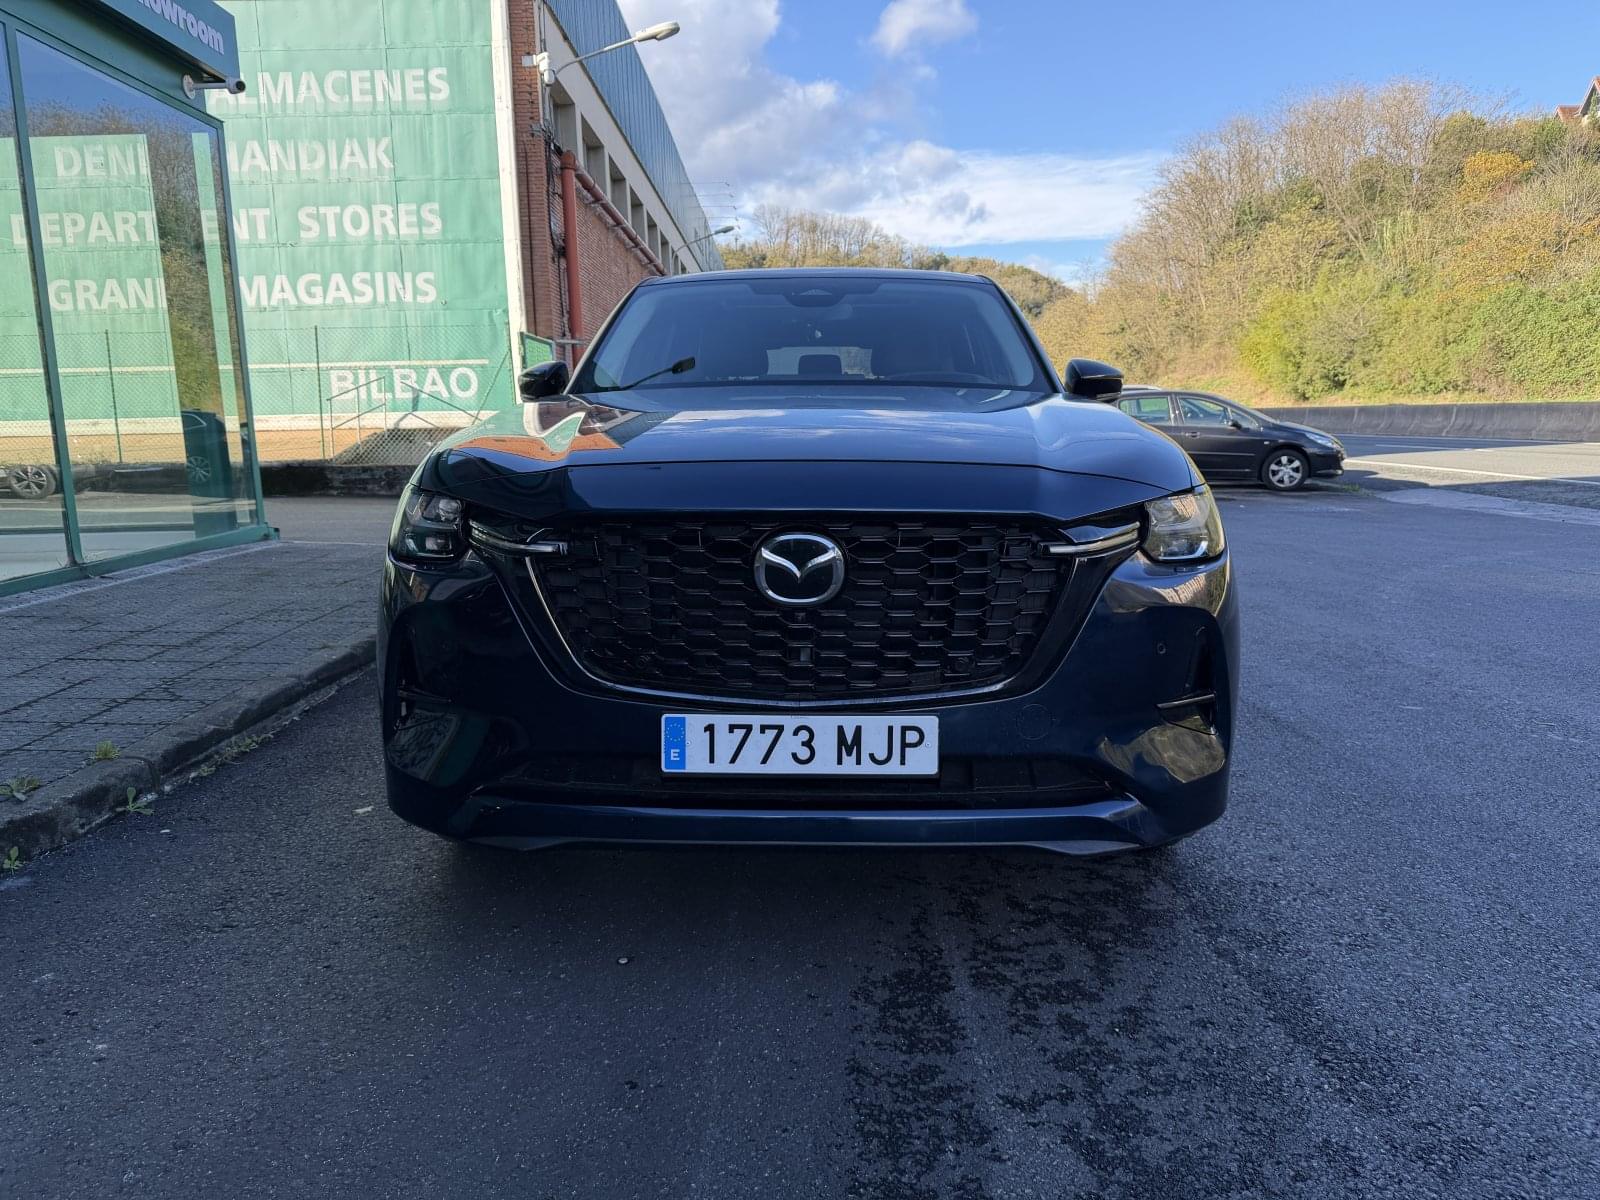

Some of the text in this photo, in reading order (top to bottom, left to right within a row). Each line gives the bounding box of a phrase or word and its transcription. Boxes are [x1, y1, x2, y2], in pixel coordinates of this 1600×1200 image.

[138, 0, 224, 55] owroom
[298, 202, 443, 239] STORES
[239, 271, 438, 307] MAGASINS
[329, 366, 479, 401] BILBAO
[670, 749, 680, 760] E
[703, 723, 926, 766] 1773 MJP
